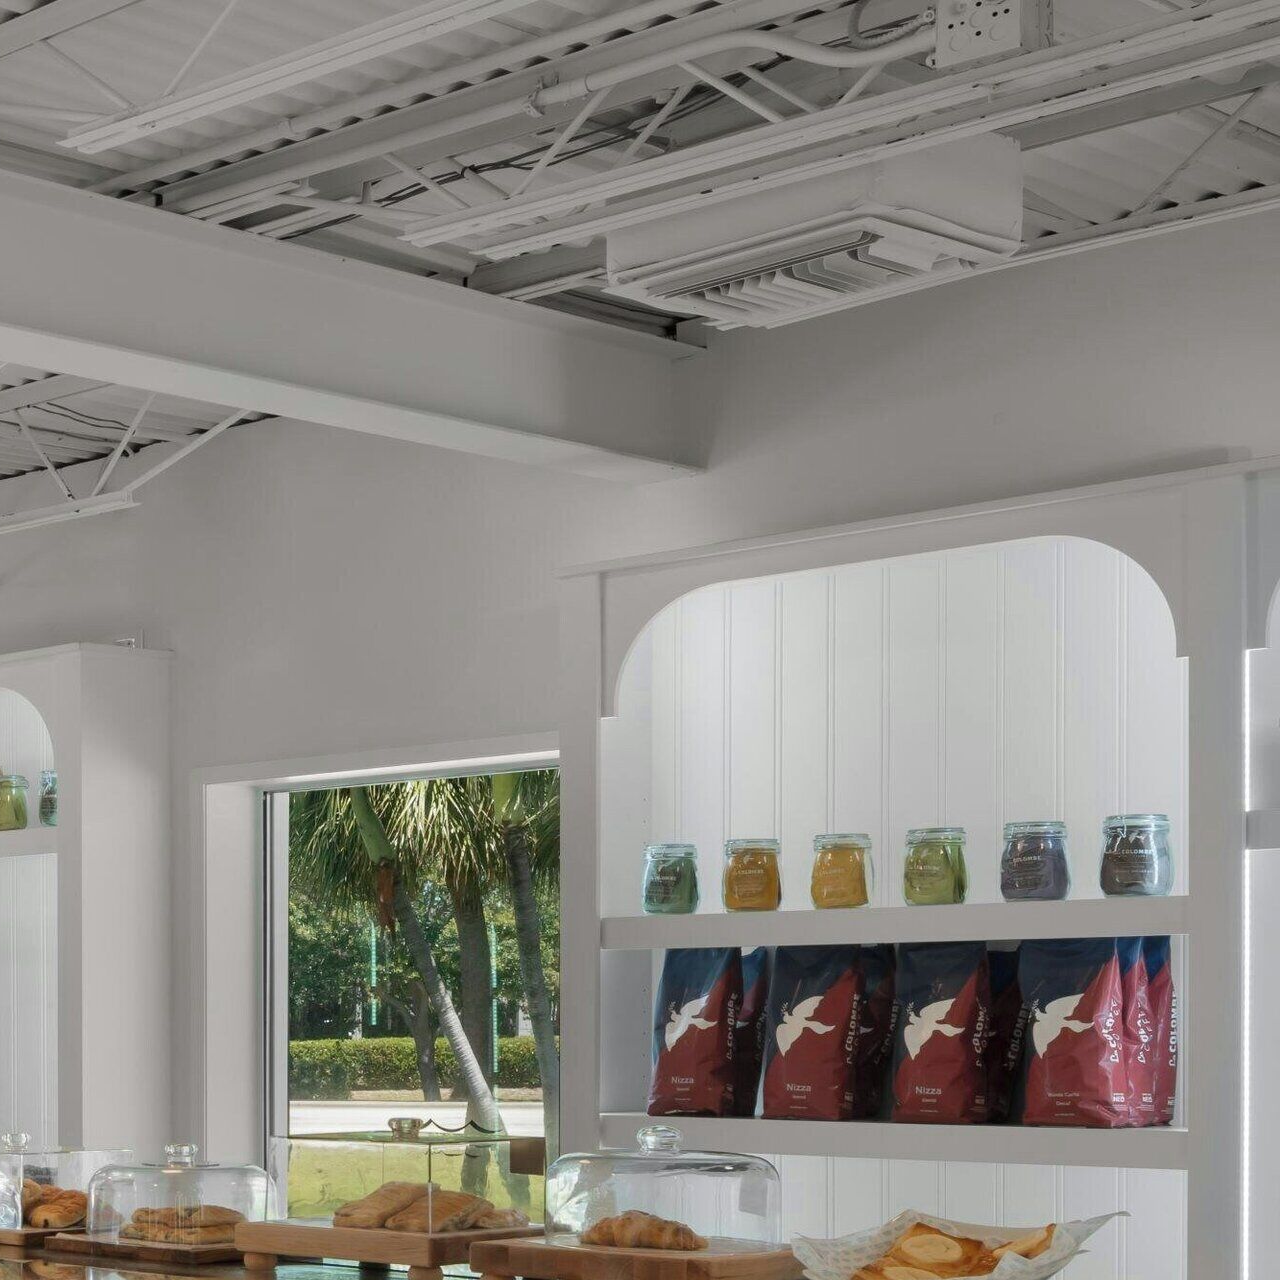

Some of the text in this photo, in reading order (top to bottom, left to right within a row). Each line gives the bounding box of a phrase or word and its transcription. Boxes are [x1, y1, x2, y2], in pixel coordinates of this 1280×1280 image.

[671, 1075, 694, 1084] Nizza
[786, 1083, 812, 1093] Nizza
[915, 1086, 942, 1095] Nizza
